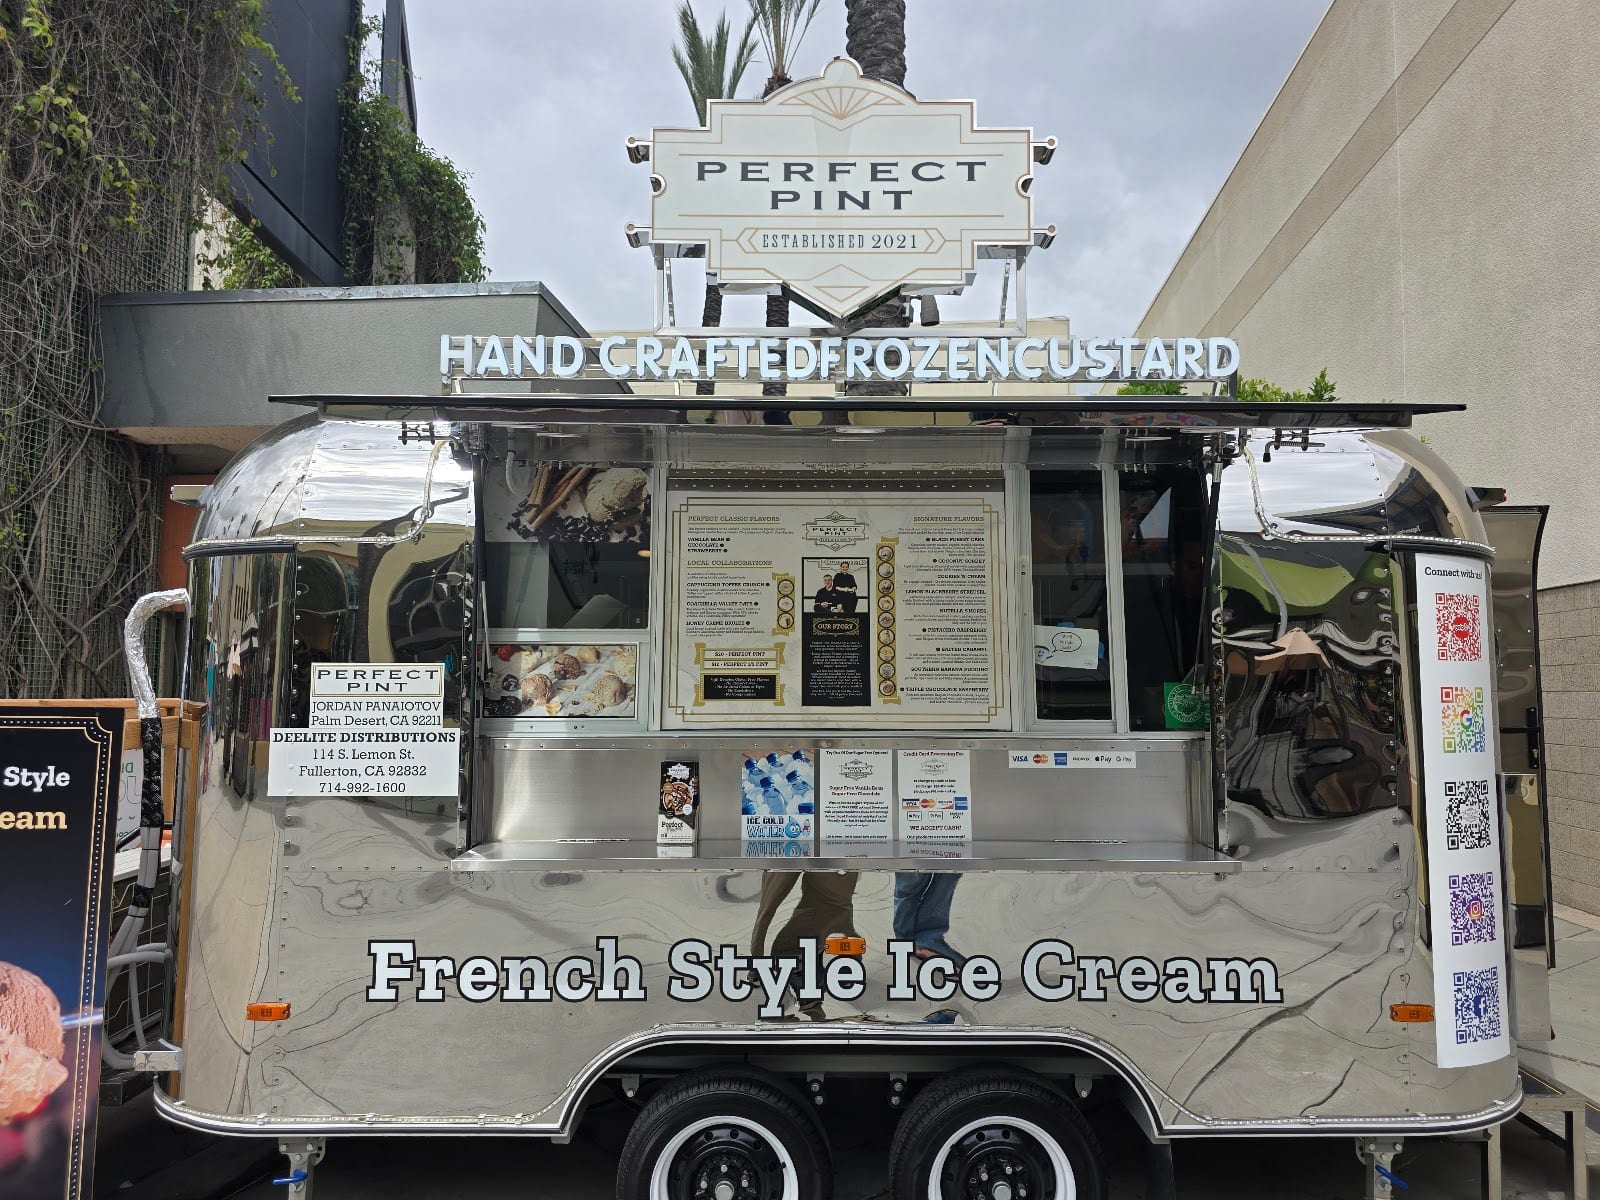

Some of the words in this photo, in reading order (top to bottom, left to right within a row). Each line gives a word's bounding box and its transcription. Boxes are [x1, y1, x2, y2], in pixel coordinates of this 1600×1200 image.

[697, 161, 987, 182] PERFECT
[770, 190, 913, 210] PINT
[762, 233, 865, 249] ESTABLISHED
[871, 233, 918, 249] 2021
[439, 334, 587, 379] HAND
[1424, 566, 1460, 577] Connect
[1460, 569, 1475, 579] with
[316, 669, 439, 680] PERFECT
[347, 682, 408, 693] PINT
[311, 701, 363, 714] JORDAN
[366, 701, 442, 712] PANAIOTOV
[311, 715, 342, 727] Palm
[344, 715, 389, 728] Desert,
[390, 715, 410, 726] CA
[411, 715, 442, 727] 92211
[272, 732, 337, 743] DEELITE
[339, 732, 456, 743] DISTRIBUTIONS
[312, 749, 335, 760] 114
[337, 749, 349, 760] S.
[351, 749, 397, 760] Lemon
[399, 749, 415, 760] St.
[1101, 755, 1112, 763] Pay
[298, 766, 361, 778] Fullerton,
[364, 766, 386, 777] CA
[388, 766, 428, 777] 92832
[3, 765, 71, 793] Style
[319, 782, 406, 793] 714-992-1600
[0, 811, 68, 830] eam
[746, 815, 761, 825] ICE
[762, 815, 784, 825] COLD
[746, 825, 785, 838] WATER
[366, 935, 648, 1003] French
[667, 935, 866, 1019] Style
[886, 937, 1002, 1002] Ice
[1021, 937, 1284, 1004] Cream
